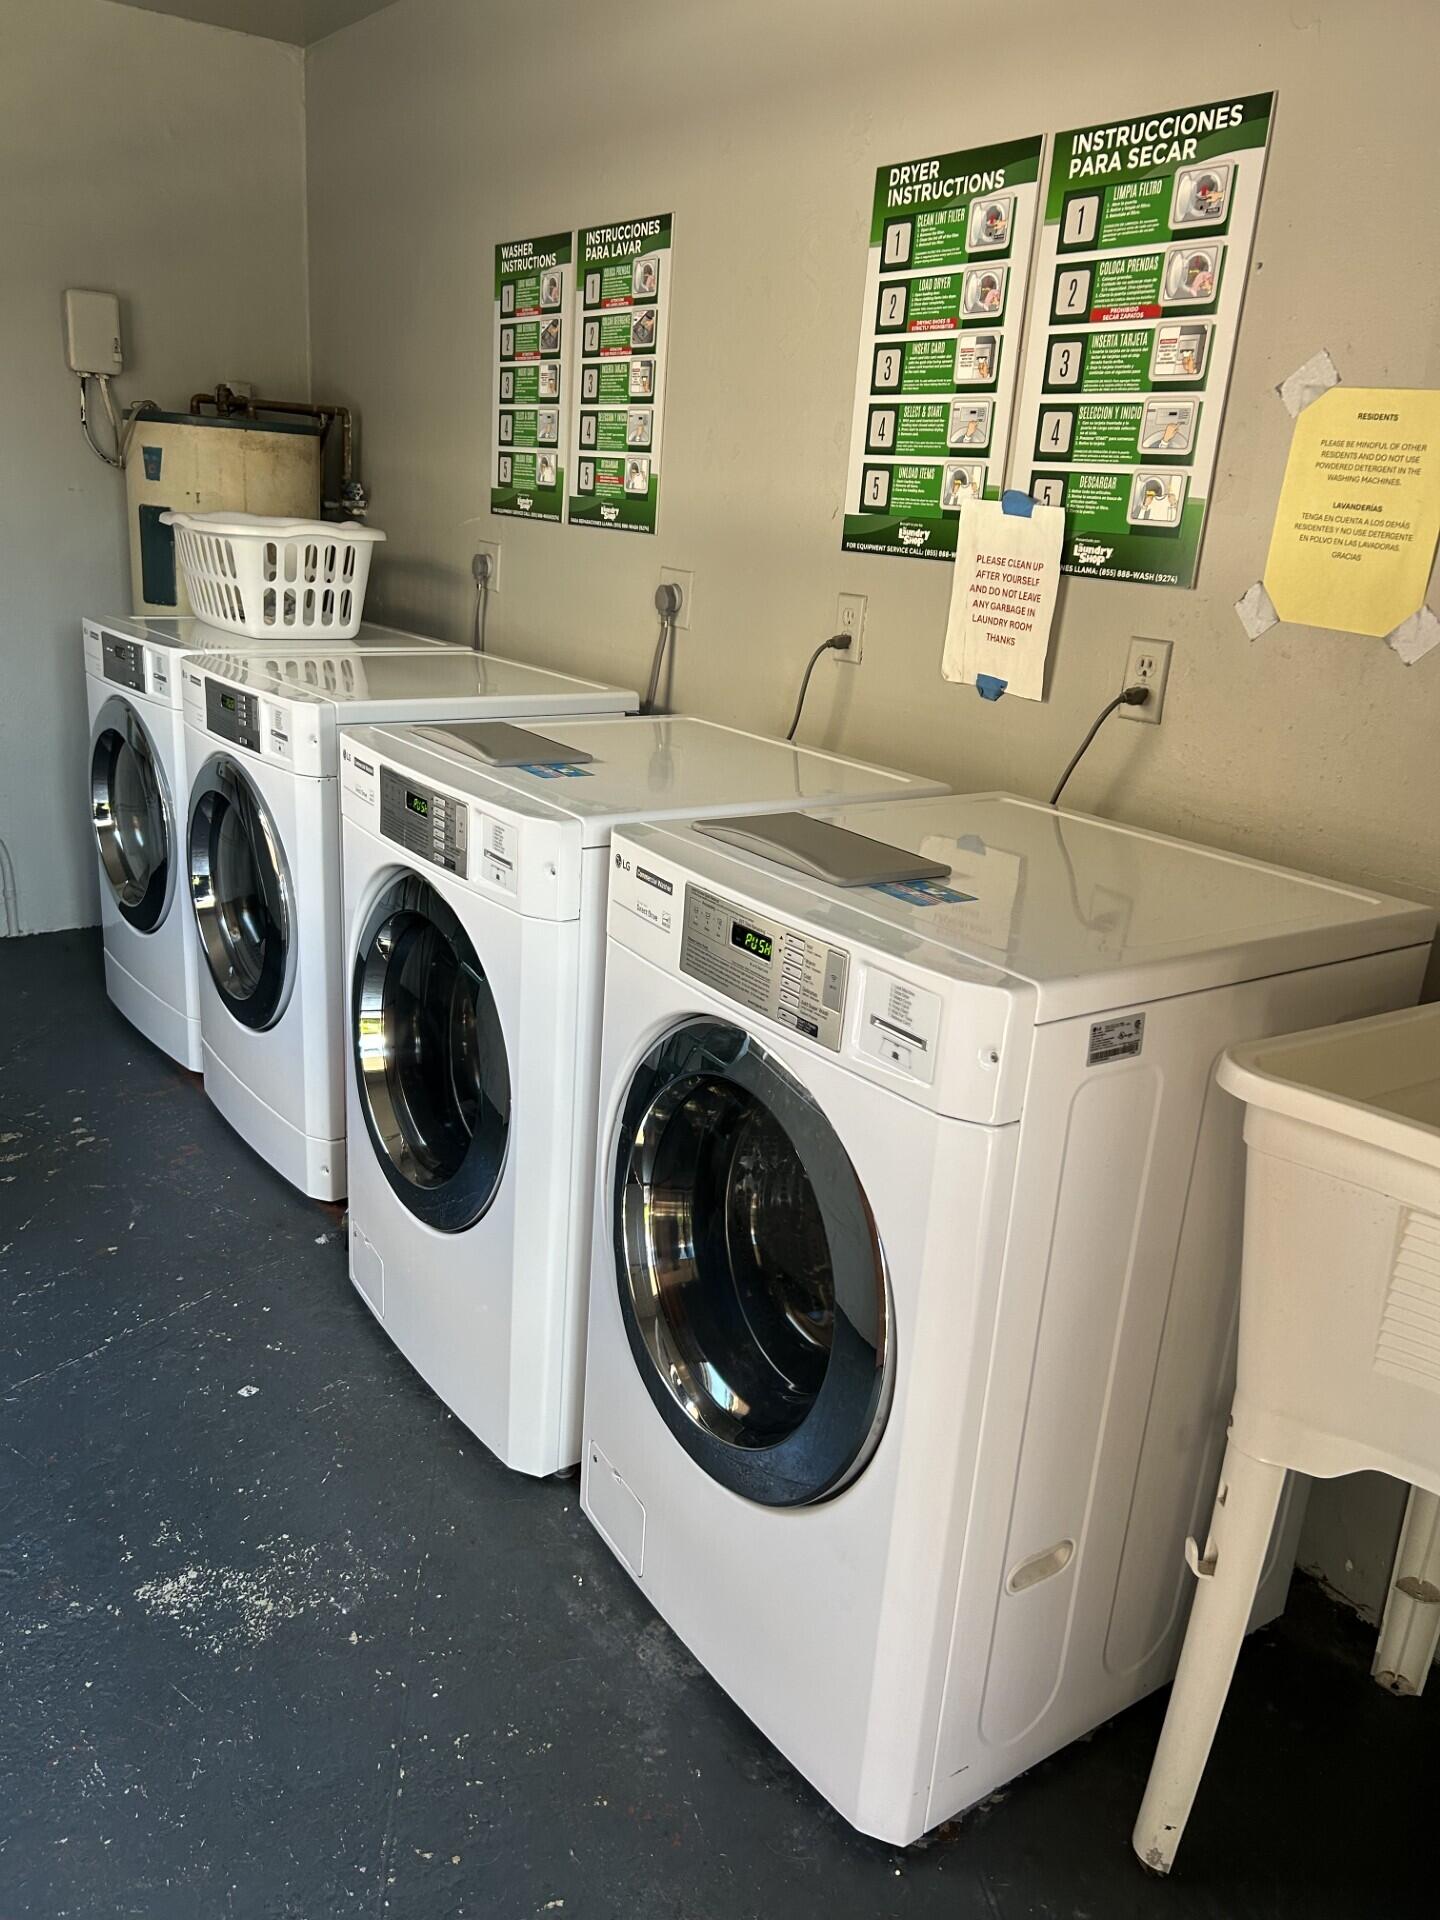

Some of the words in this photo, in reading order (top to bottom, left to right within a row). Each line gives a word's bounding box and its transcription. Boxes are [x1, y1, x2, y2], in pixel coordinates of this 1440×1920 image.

[1071, 103, 1244, 156] INSTRUCCIONES
[1068, 149, 1122, 179] PARA
[1126, 138, 1198, 170] SECAR
[889, 160, 940, 186] DRYER
[887, 169, 1005, 208] INSTRUCTIONS
[1113, 184, 1137, 201] LIMPIA
[1138, 179, 1162, 197] FILTRO
[917, 212, 934, 227] CLEAN
[935, 210, 948, 224] LINT
[948, 208, 965, 223] FILTER
[1078, 205, 1085, 236] 1
[586, 220, 660, 246] INSTRUCCIONES
[502, 242, 533, 260] WASHER
[586, 244, 609, 261] PARA
[611, 240, 641, 257] LAVAR
[895, 230, 901, 256] 1
[502, 252, 556, 274] INSTRUCTIONS
[1099, 260, 1125, 276] COLOCA
[1126, 256, 1159, 273] PRENDAS
[919, 279, 933, 291] LOAD
[933, 276, 951, 290] DRYER
[1067, 278, 1078, 308] 2
[889, 294, 897, 319] 2
[506, 334, 510, 351] 2
[590, 327, 594, 346] 2
[1091, 333, 1118, 348] INSERTA
[1120, 332, 1148, 347] TARJETA
[912, 342, 930, 354] INSERT
[931, 341, 946, 354] CARD
[884, 356, 892, 380] 3
[1059, 349, 1070, 378] 3
[505, 376, 510, 394] 3
[588, 374, 593, 393] 3
[904, 405, 921, 418] SELECT
[922, 405, 926, 418] &
[927, 405, 943, 418] START
[1078, 406, 1114, 420] SELECCION
[1114, 406, 1120, 419] Y
[1120, 406, 1142, 420] INICIO
[1358, 412, 1399, 421] RESIDENTS
[504, 419, 508, 436] 4
[586, 421, 591, 439] 4
[878, 417, 885, 440] 4
[1050, 418, 1061, 447] 4
[1320, 439, 1345, 448] PLEASE
[1346, 440, 1356, 448] BE
[1356, 441, 1388, 450] MINDFUL
[1401, 443, 1427, 452] OTHER
[1321, 450, 1358, 460] RESIDENTS
[1358, 452, 1374, 461] AND
[1376, 454, 1387, 462] DO
[1388, 454, 1404, 463] NOT
[1406, 456, 1420, 464] USE
[503, 461, 508, 478] 5
[585, 466, 589, 485] 5
[898, 467, 918, 479] UNLOAD
[920, 467, 936, 480] ITEMS
[1315, 462, 1353, 472] POWDERED
[1354, 464, 1398, 474] DETERGENT
[1399, 466, 1406, 474] IN
[1407, 467, 1422, 476] THE
[1079, 475, 1118, 489] DESCARGAR
[1328, 474, 1360, 483] WASHING
[872, 476, 880, 500] 5
[1043, 486, 1052, 506] 5
[1332, 500, 1383, 512] LAVANDERÍAS
[1302, 512, 1322, 520] TENGA
[1324, 514, 1334, 522] EN
[1335, 515, 1362, 525] CUENTA
[1370, 518, 1384, 527] LOS
[1385, 518, 1410, 529] DEMÁS
[898, 528, 930, 540] Laundry
[1294, 523, 1334, 533] RESIDENTES
[1340, 527, 1352, 535] NO
[1353, 528, 1367, 537] USE
[1368, 530, 1413, 542] DETERGENTE
[1309, 535, 1332, 544] POLVO
[1333, 538, 1343, 546] EN
[1344, 539, 1357, 547] LAS
[857, 543, 886, 551] EQUIPMENT
[887, 546, 908, 554] SERVICE
[1073, 544, 1114, 559] Laundry
[1332, 551, 1361, 561] GRACIAS
[976, 555, 1006, 566] PLEASE
[1008, 558, 1030, 570] CLEAN
[1033, 562, 1044, 572] UP
[976, 570, 1000, 580] AFTER
[1002, 573, 1040, 587] YOURSELF
[1074, 566, 1098, 575] LLAMA:
[1099, 567, 1116, 578] (855)
[1117, 568, 1154, 581] 888-WASH
[1155, 574, 1178, 584] (9274)
[970, 584, 988, 593] AND
[989, 586, 1000, 596] DO
[1002, 588, 1018, 598] NOT
[1019, 591, 1041, 603] LEAVE
[972, 600, 990, 609] ANY
[990, 602, 1026, 616] GARBAGE
[1027, 608, 1036, 617] IN
[972, 614, 1008, 627] LAUNDRY
[1010, 620, 1032, 632] ROOM
[986, 632, 1016, 646] THANKS
[622, 859, 630, 871] LG
[745, 933, 772, 955] PUSH
